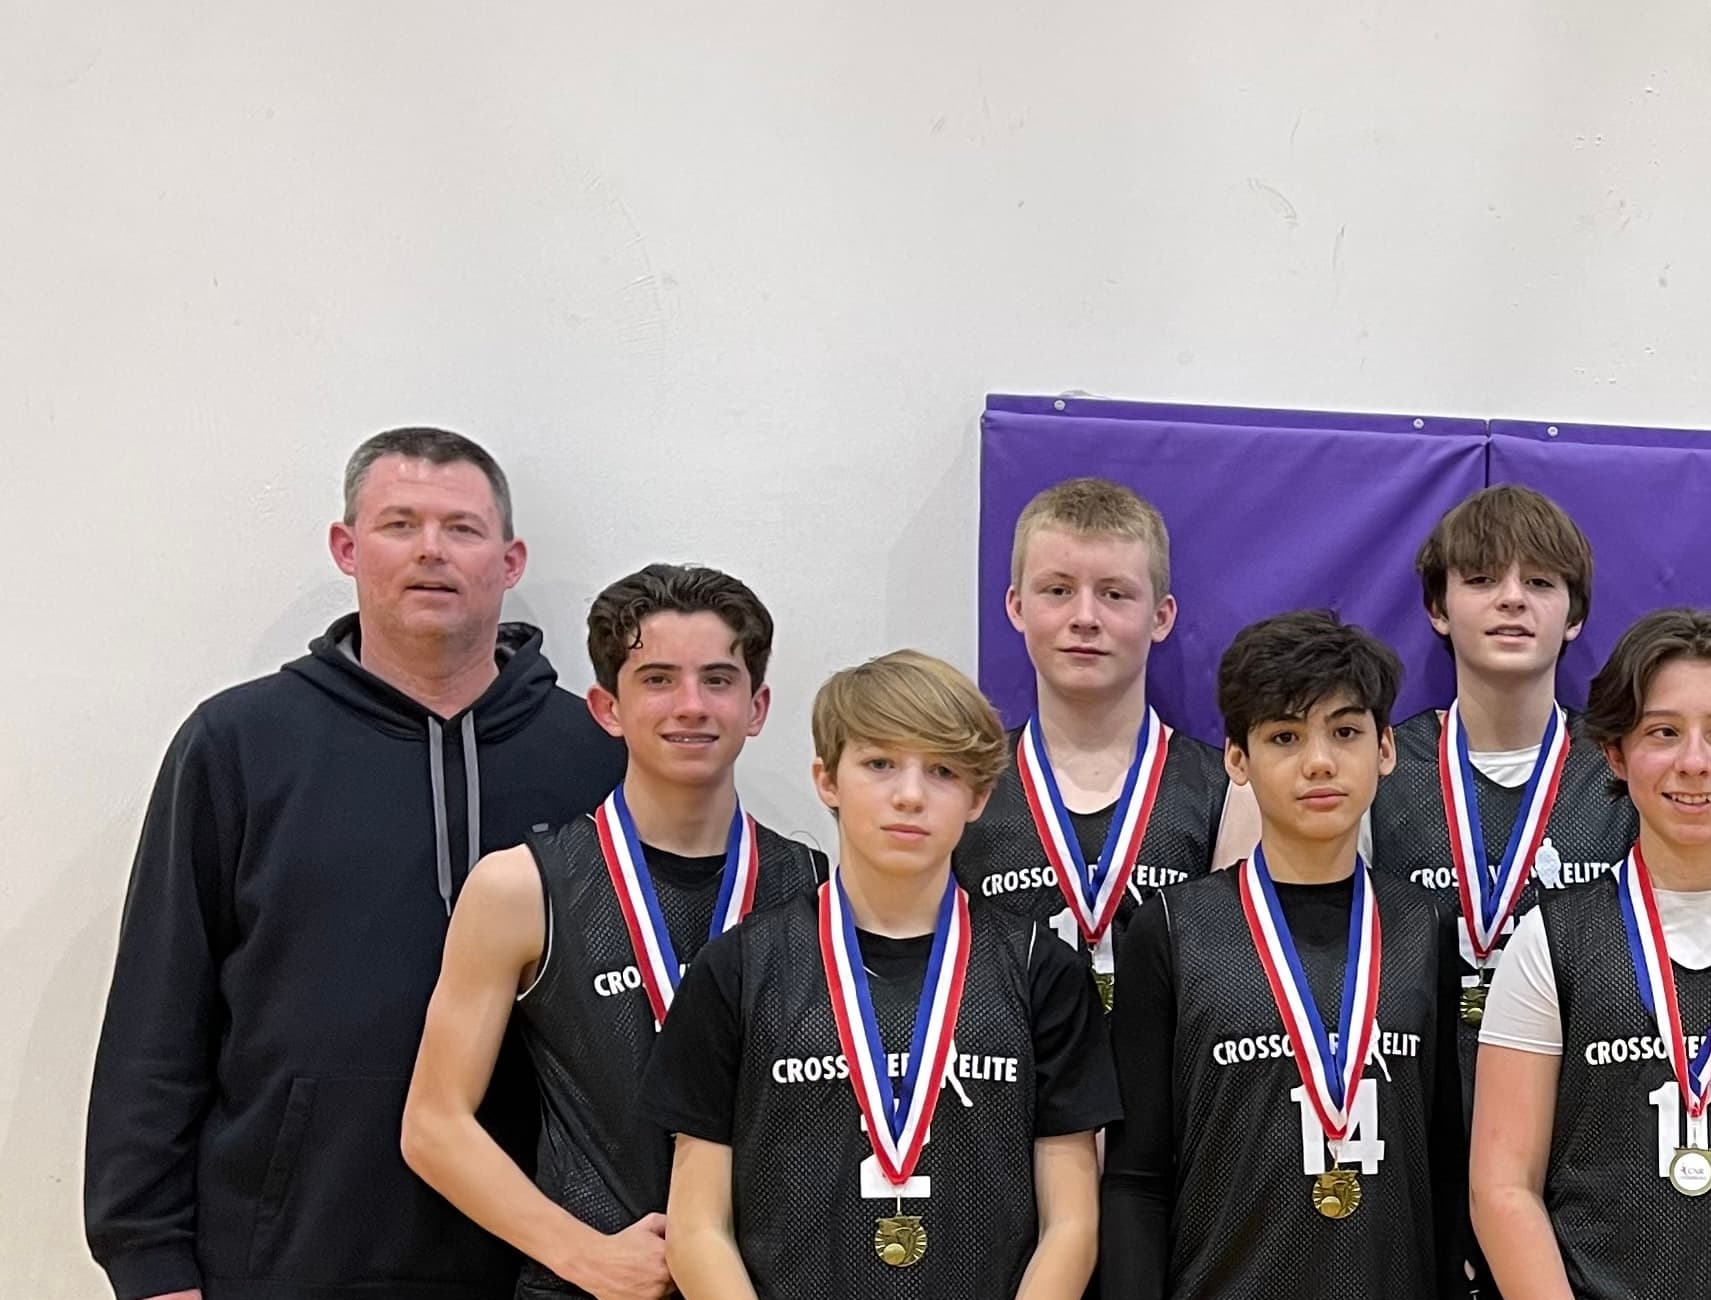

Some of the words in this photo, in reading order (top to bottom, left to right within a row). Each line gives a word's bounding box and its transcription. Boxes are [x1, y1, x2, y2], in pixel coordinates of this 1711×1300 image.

[1383, 1031, 1421, 1057] ELIT
[959, 1053, 1018, 1082] ELITE
[1290, 1078, 1385, 1176] 14
